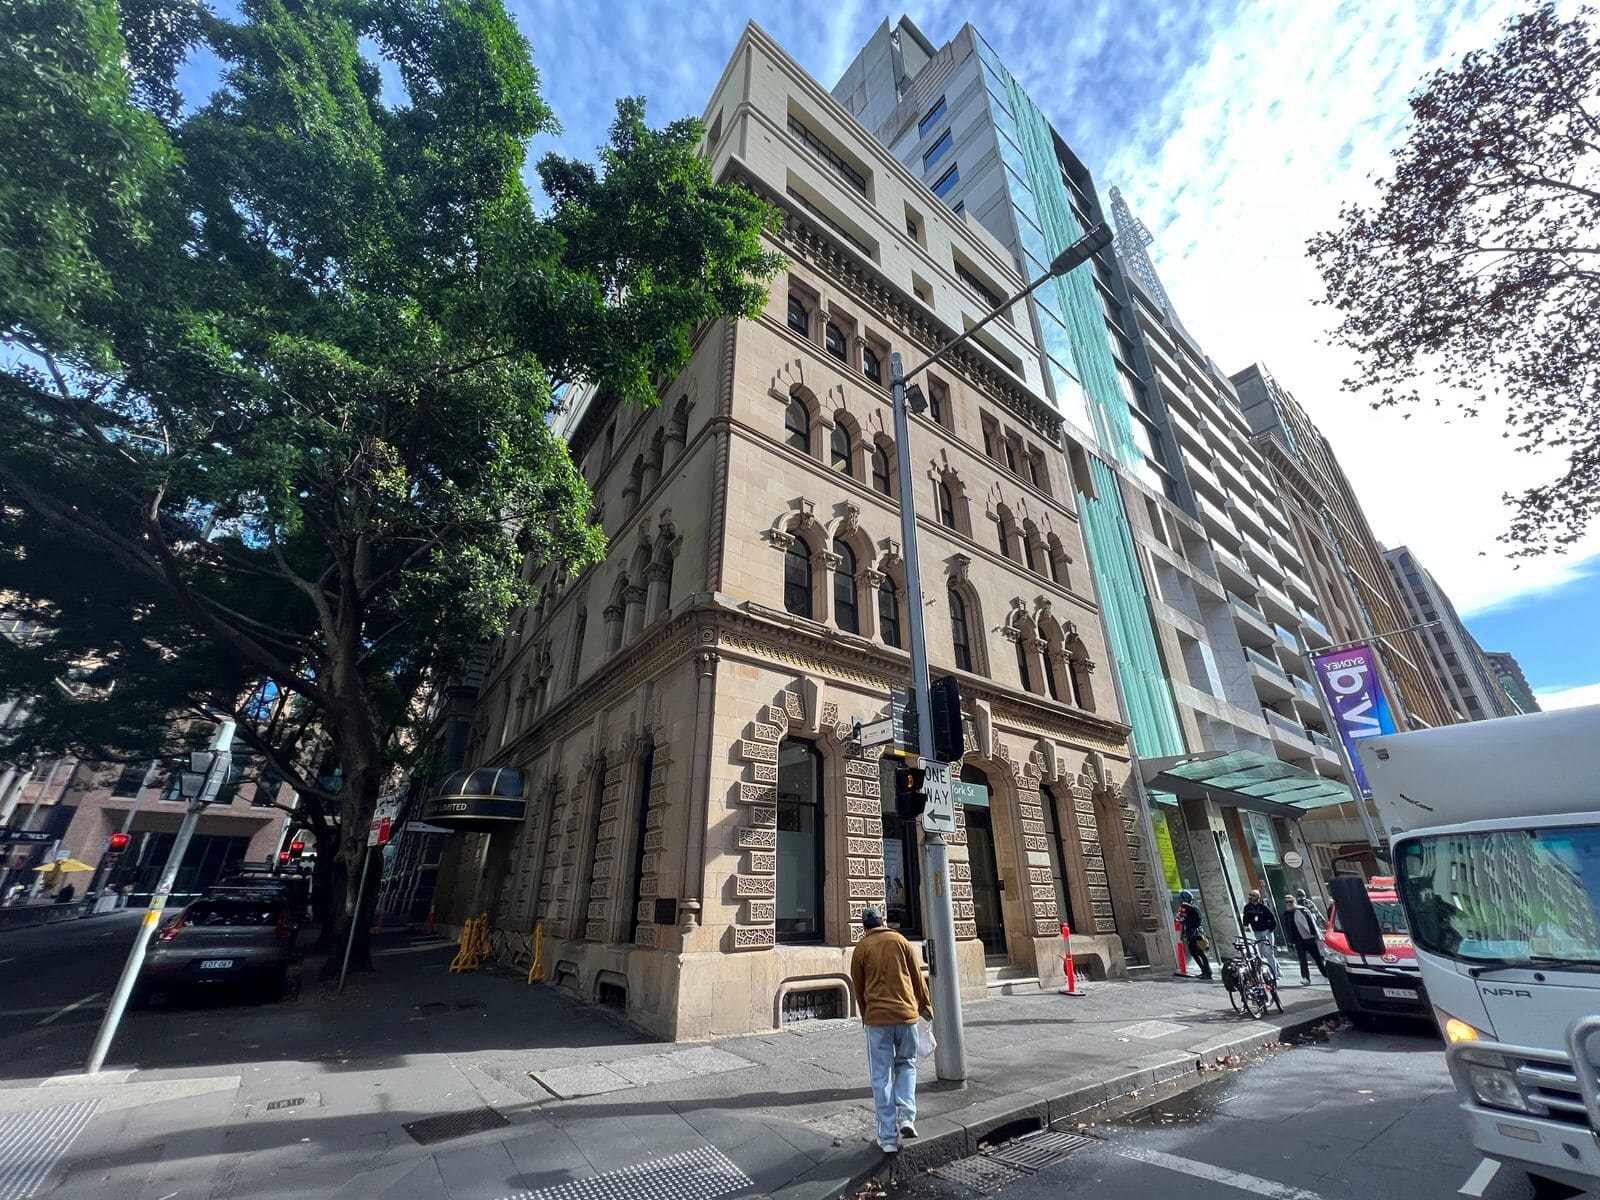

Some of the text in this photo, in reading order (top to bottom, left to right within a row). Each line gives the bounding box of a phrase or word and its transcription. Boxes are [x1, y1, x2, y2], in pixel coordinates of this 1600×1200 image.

[925, 766, 947, 784] ONE
[924, 787, 949, 805] WAY
[1482, 987, 1533, 998] NPR
